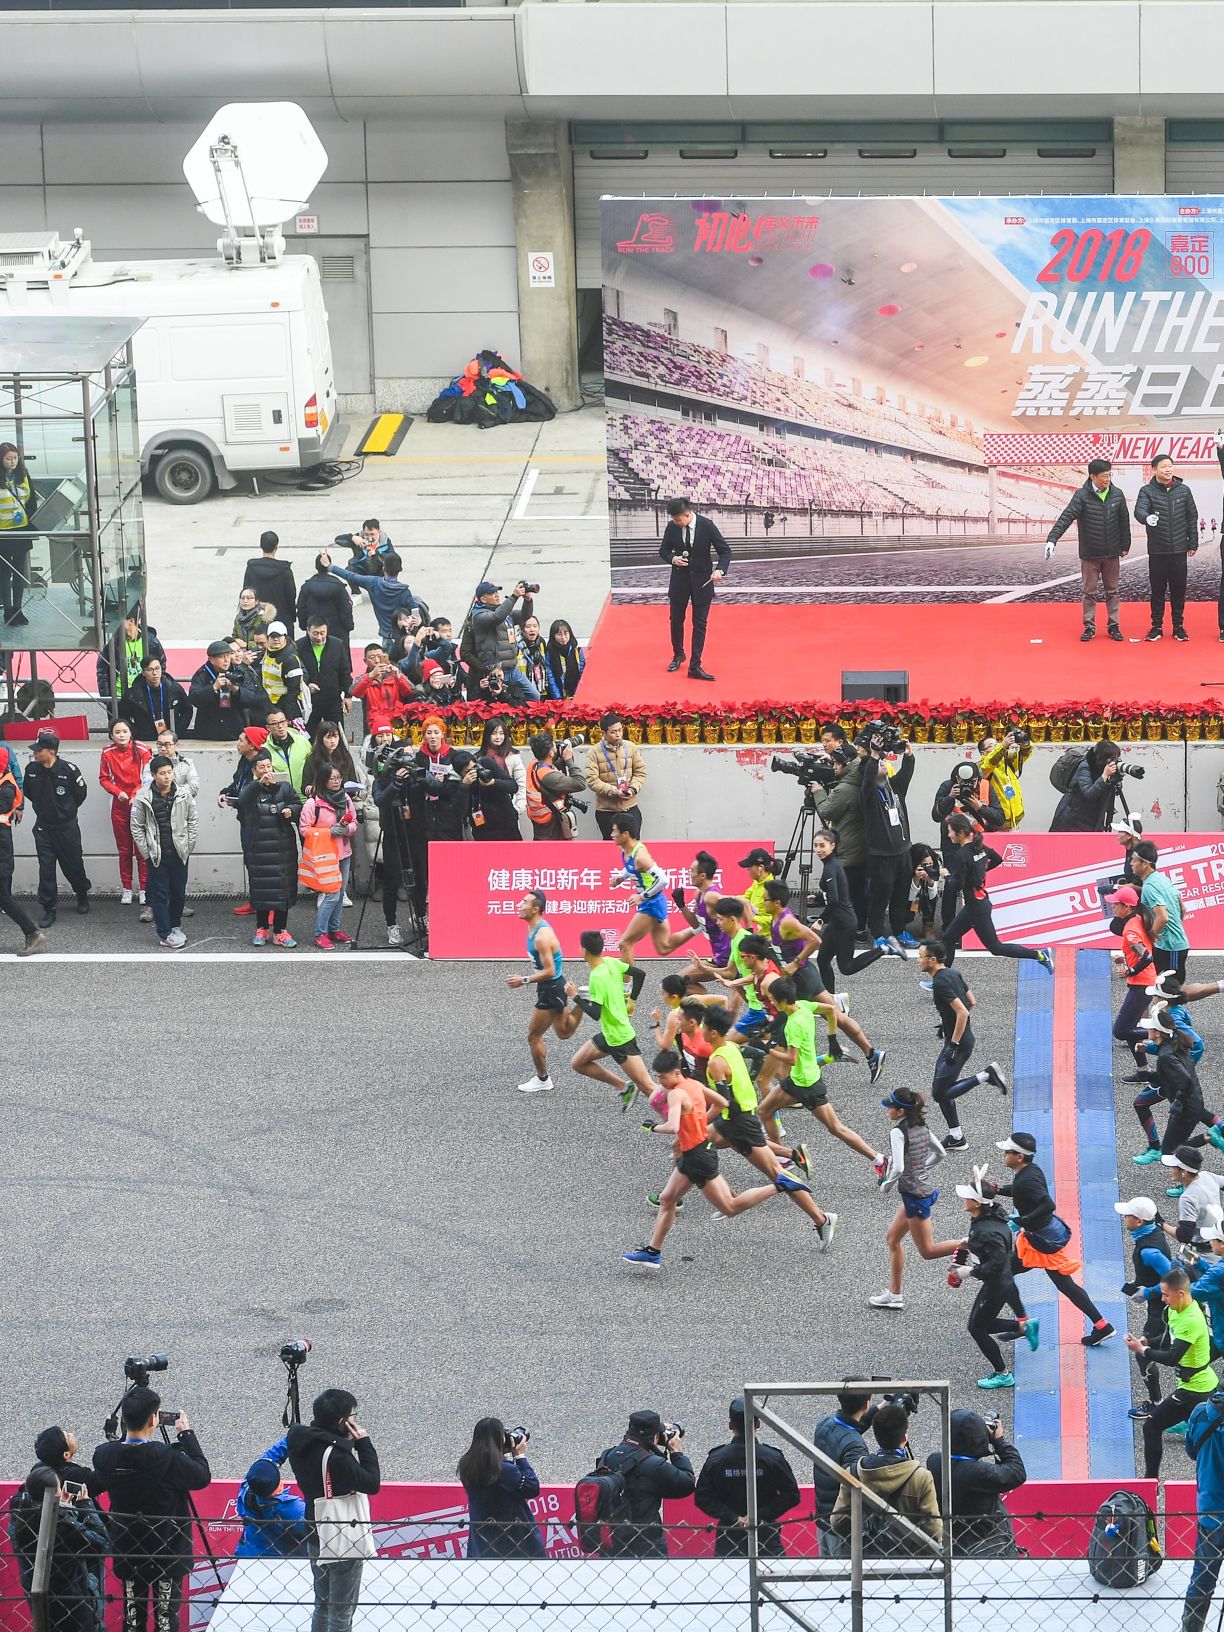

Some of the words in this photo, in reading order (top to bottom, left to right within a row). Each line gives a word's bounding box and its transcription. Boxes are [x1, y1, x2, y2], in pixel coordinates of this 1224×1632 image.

[1170, 234, 1209, 253] 嘉定
[1036, 228, 1152, 283] 2018
[1170, 255, 1209, 275] 800
[1011, 291, 1136, 353] RUN
[1098, 434, 1119, 444] 2018
[1114, 436, 1164, 460] NEW
[1167, 436, 1215, 460] YEAR
[487, 868, 602, 891] 健康迎新年
[1067, 886, 1102, 914] RU
[1180, 887, 1200, 899] EAR
[487, 900, 630, 915] 元旦健身迎新活动
[526, 1494, 561, 1516] 018
